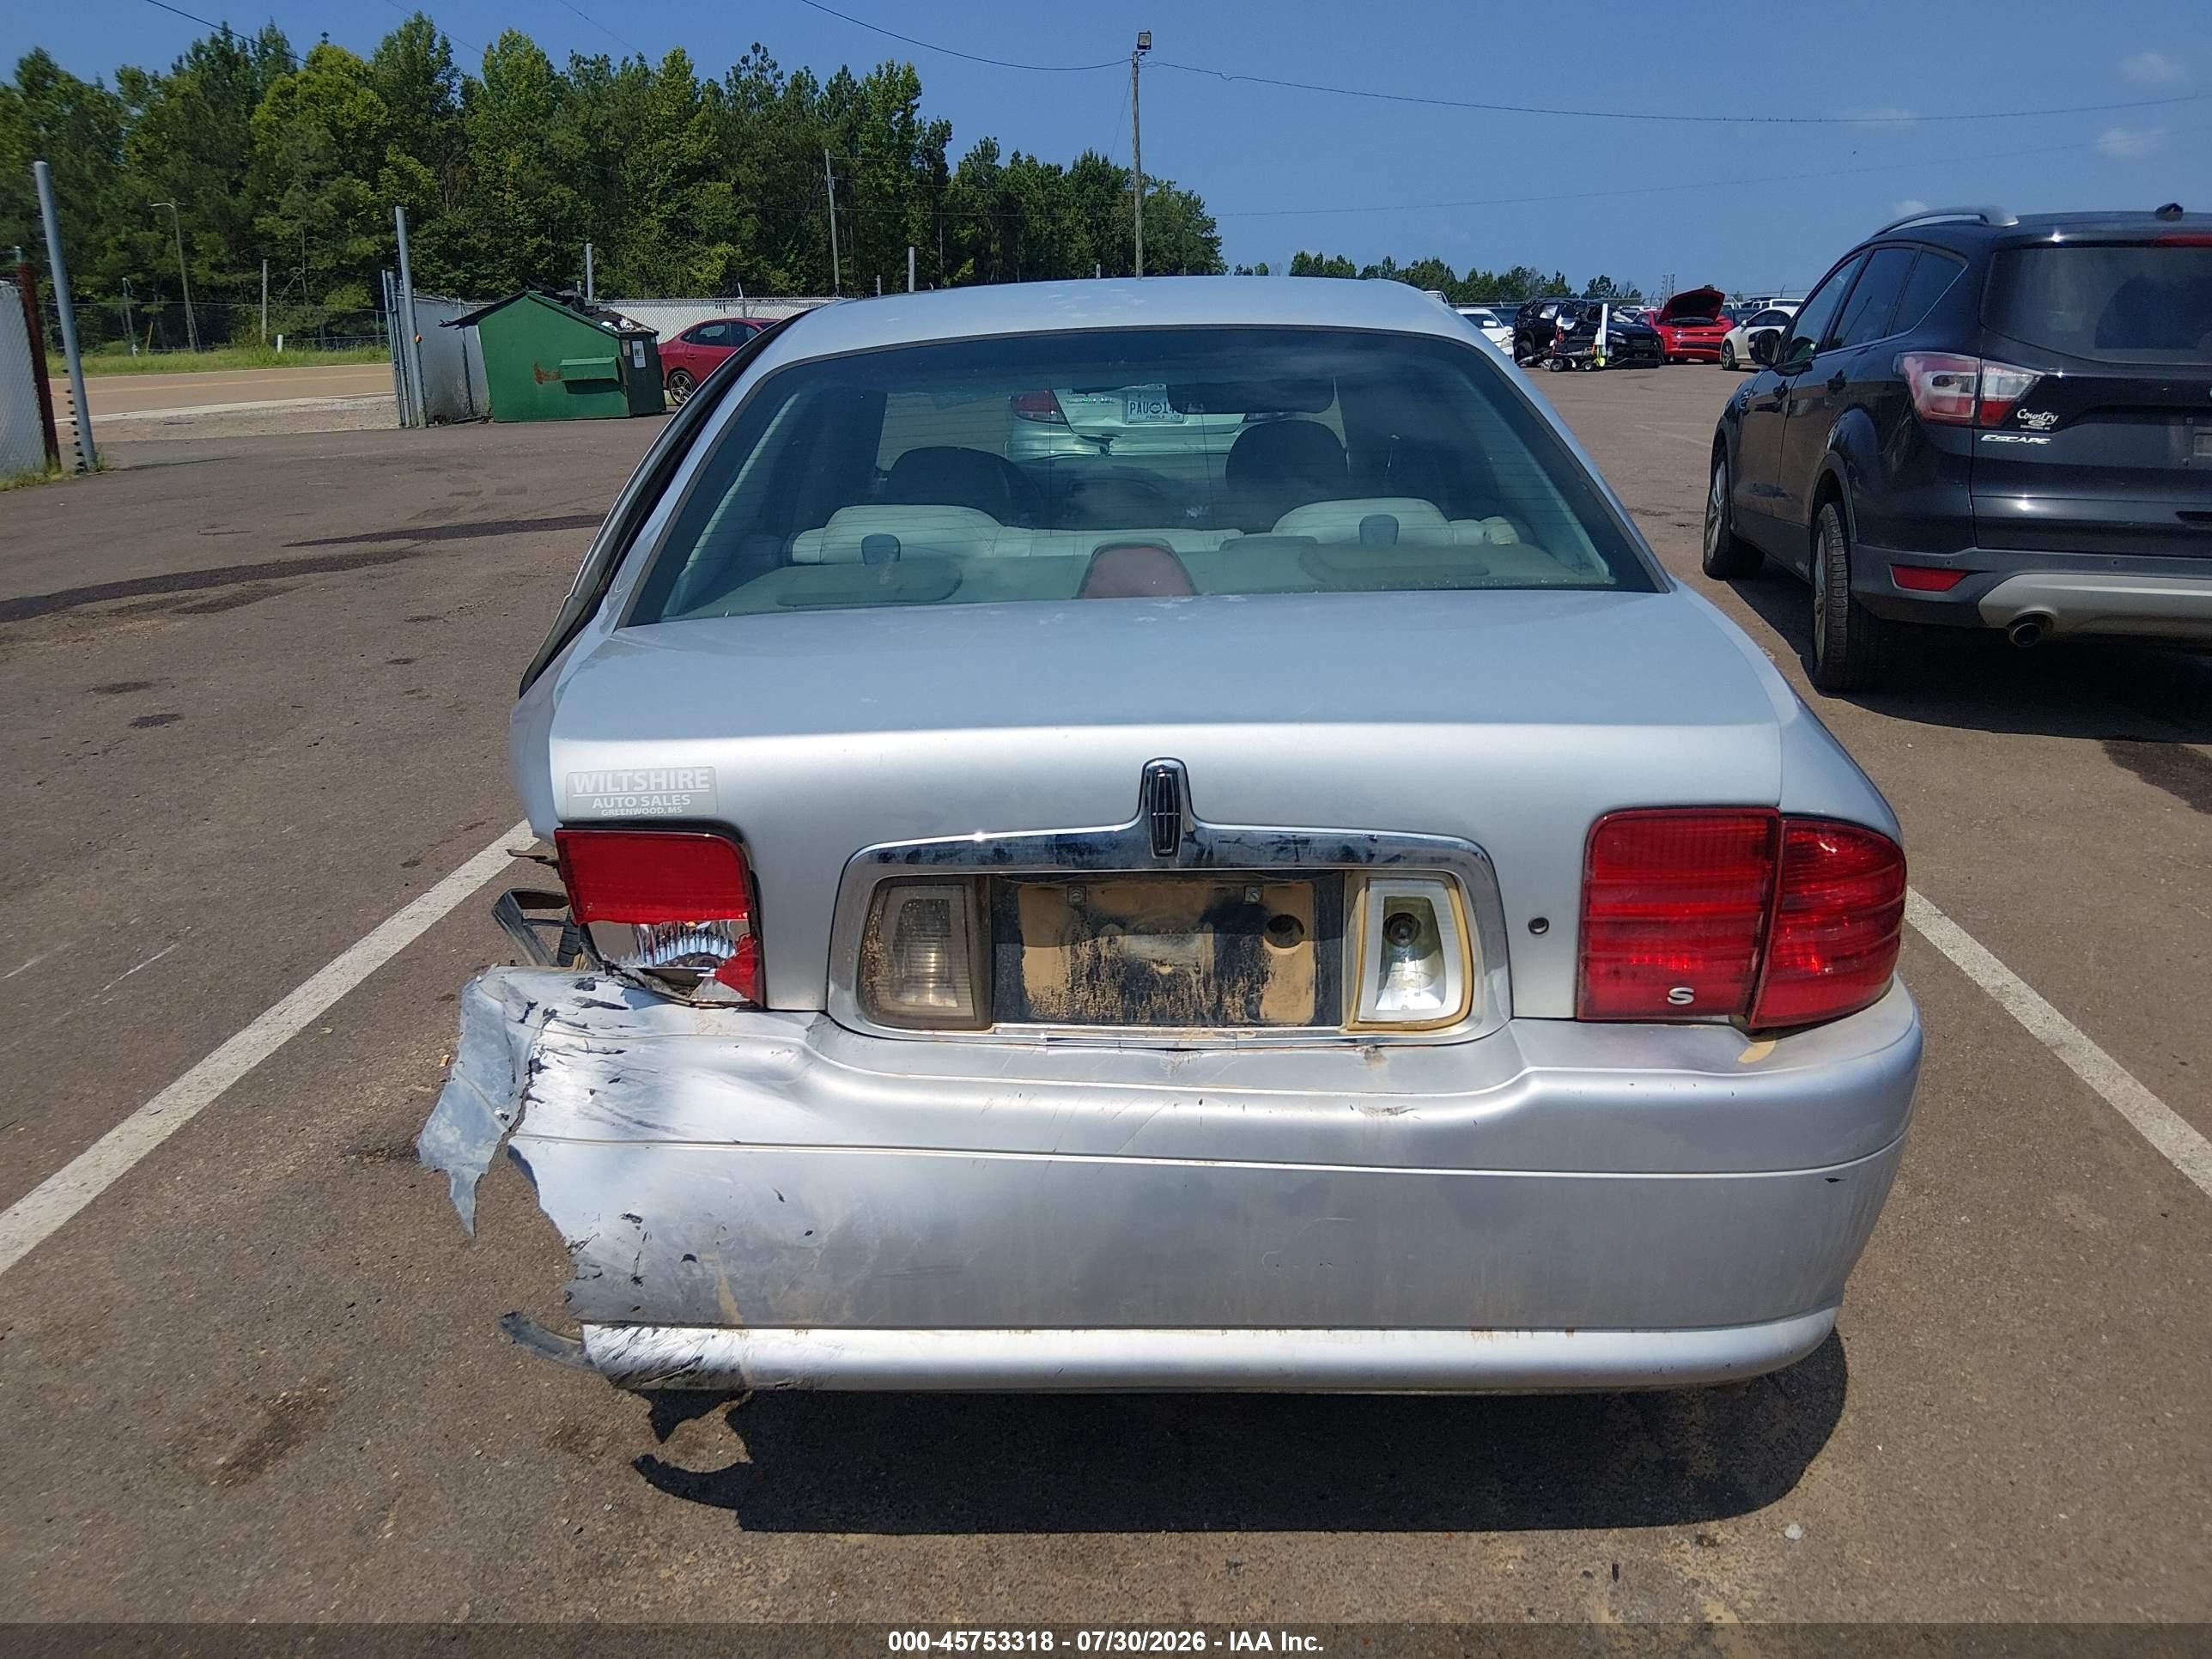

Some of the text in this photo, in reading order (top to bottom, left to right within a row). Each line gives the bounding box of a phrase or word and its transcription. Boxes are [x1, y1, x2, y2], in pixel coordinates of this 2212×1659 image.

[1129, 401, 1149, 414] PAU
[2016, 408, 2059, 425] Country
[1980, 434, 2051, 445] ESCAPE
[573, 769, 710, 793] WILTSHIRE
[592, 794, 691, 809] AUTO SALES
[1667, 987, 1694, 1005] S
